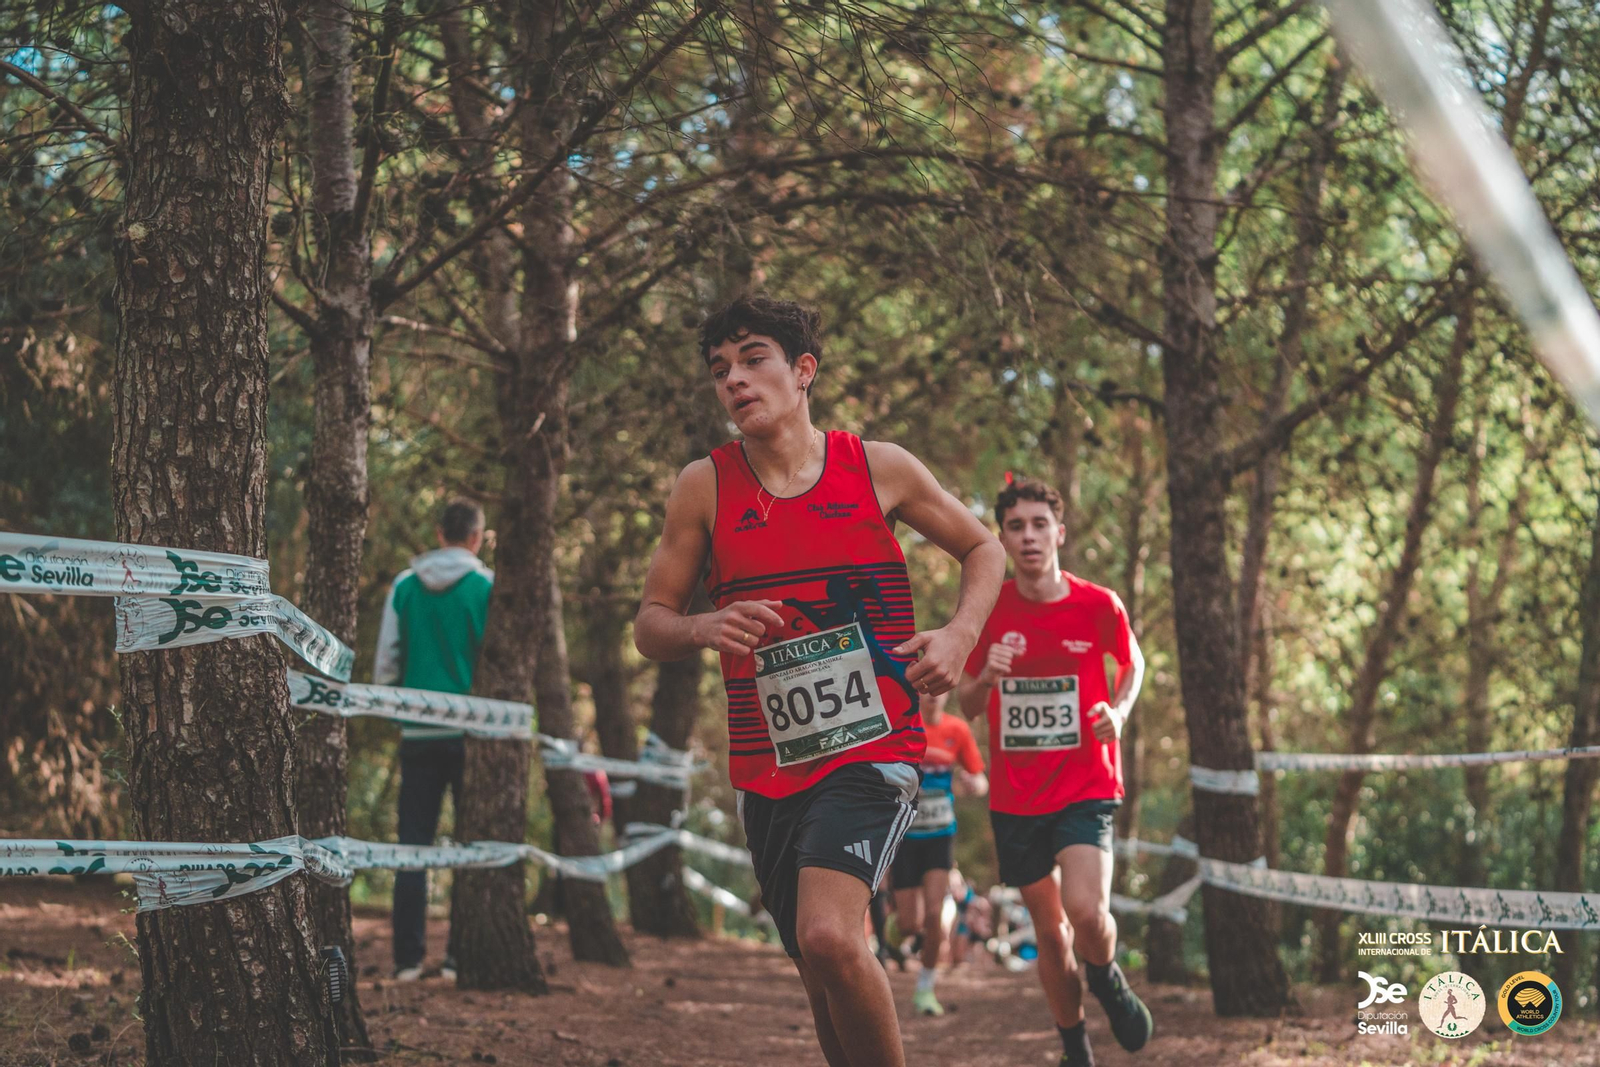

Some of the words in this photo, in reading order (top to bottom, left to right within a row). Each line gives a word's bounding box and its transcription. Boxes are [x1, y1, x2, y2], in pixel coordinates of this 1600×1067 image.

[30, 564, 95, 588] Sevilla
[770, 637, 832, 665] ITÁLICA
[766, 670, 872, 732] 8054
[1008, 704, 1074, 729] 8053
